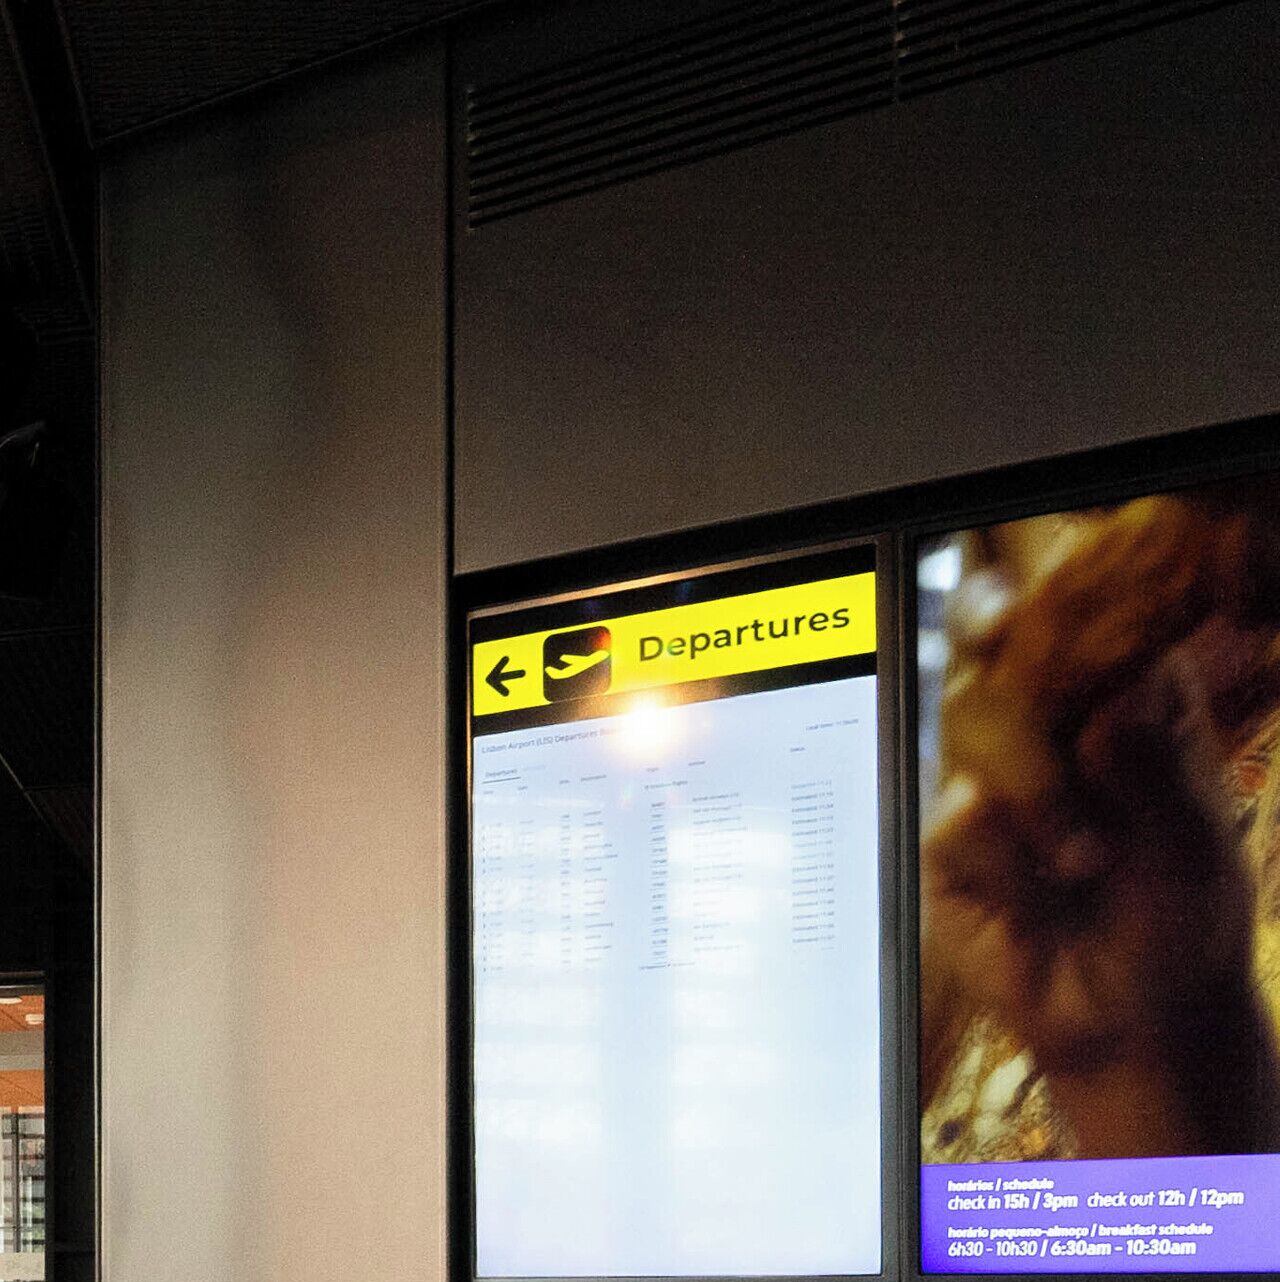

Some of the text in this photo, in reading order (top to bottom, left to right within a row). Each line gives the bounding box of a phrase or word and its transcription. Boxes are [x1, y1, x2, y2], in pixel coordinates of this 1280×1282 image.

[639, 607, 850, 663] Departures
[508, 739, 535, 750] Airport
[1003, 1178, 1054, 1190] schedule
[947, 1195, 986, 1211] check
[987, 1195, 1001, 1210] in
[1003, 1193, 1030, 1209] 15h
[1042, 1192, 1078, 1212] 3pm
[1087, 1192, 1127, 1208] check
[1129, 1191, 1156, 1207] out
[1158, 1189, 1186, 1206] 12h
[1200, 1188, 1244, 1209] 12pm
[1098, 1223, 1157, 1236] breakfast
[1158, 1223, 1213, 1236] schedule
[947, 1241, 984, 1257] 6h30
[996, 1240, 1038, 1257] 10h30
[1050, 1240, 1112, 1256] 6:30am
[1126, 1238, 1197, 1256] 10:30am
